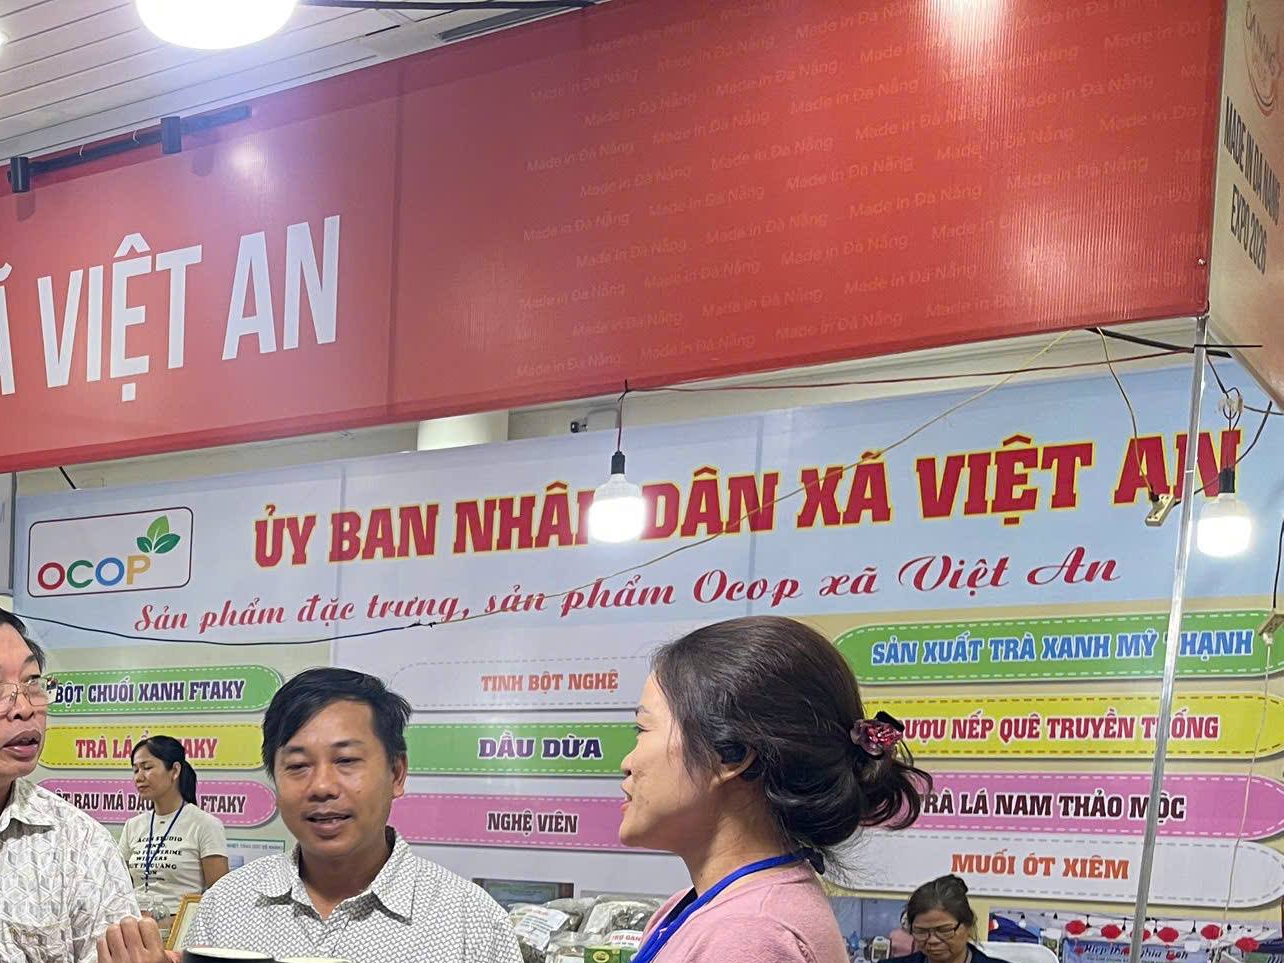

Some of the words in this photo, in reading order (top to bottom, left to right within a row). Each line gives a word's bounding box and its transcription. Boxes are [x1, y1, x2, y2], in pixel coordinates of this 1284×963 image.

[1230, 183, 1249, 252] EXPO
[1249, 212, 1266, 275] 2026
[37, 232, 203, 402] VIỆT
[221, 215, 340, 361] AN
[254, 504, 315, 568] ỦY
[328, 504, 439, 564] BAN
[642, 466, 779, 541] DÂN
[796, 449, 891, 529] XÃ
[916, 434, 1094, 526] VIỆT
[1113, 429, 1242, 505] AN
[37, 555, 151, 590] OCOP
[134, 604, 188, 632] Sản
[199, 597, 284, 634] phẩm
[297, 593, 355, 626] đặc
[484, 584, 548, 614] sản
[560, 573, 676, 618] phẩm
[693, 569, 801, 608] Ocop
[818, 567, 880, 597] xã
[898, 554, 1009, 597] Việt
[1027, 546, 1120, 585] An
[871, 637, 918, 666] SẢN
[922, 631, 984, 664] XUẤT
[989, 631, 1038, 662] TRÀ
[1042, 637, 1108, 661] XANH
[1116, 631, 1158, 659] MỸ
[1165, 630, 1254, 667] HẠNH
[88, 676, 134, 703] CHUỐI
[139, 681, 184, 702] XANH
[189, 680, 245, 701] FTAKY
[481, 674, 523, 692] TINH
[528, 671, 564, 694] BỘT
[568, 669, 619, 693] NGHỆ
[900, 718, 946, 744] ƯỢU
[951, 709, 994, 740] NẾP
[999, 712, 1041, 743] QUÊ
[1046, 707, 1135, 741] TRUYỀN
[75, 735, 108, 758] TRÀ
[112, 734, 132, 758] LÁ
[478, 730, 534, 758] DẦU
[542, 734, 603, 758] DỪA
[74, 793, 99, 810] RAU
[103, 790, 124, 811] MÁ
[200, 794, 246, 813] FTAKY
[960, 788, 989, 816] LÁ
[995, 795, 1052, 817] NAM
[1059, 789, 1122, 817] THẢO
[487, 808, 532, 834] NGHỆ
[538, 810, 578, 833] VIÊN
[950, 848, 1016, 876] MUỐI
[1062, 852, 1130, 880] XIÊM
